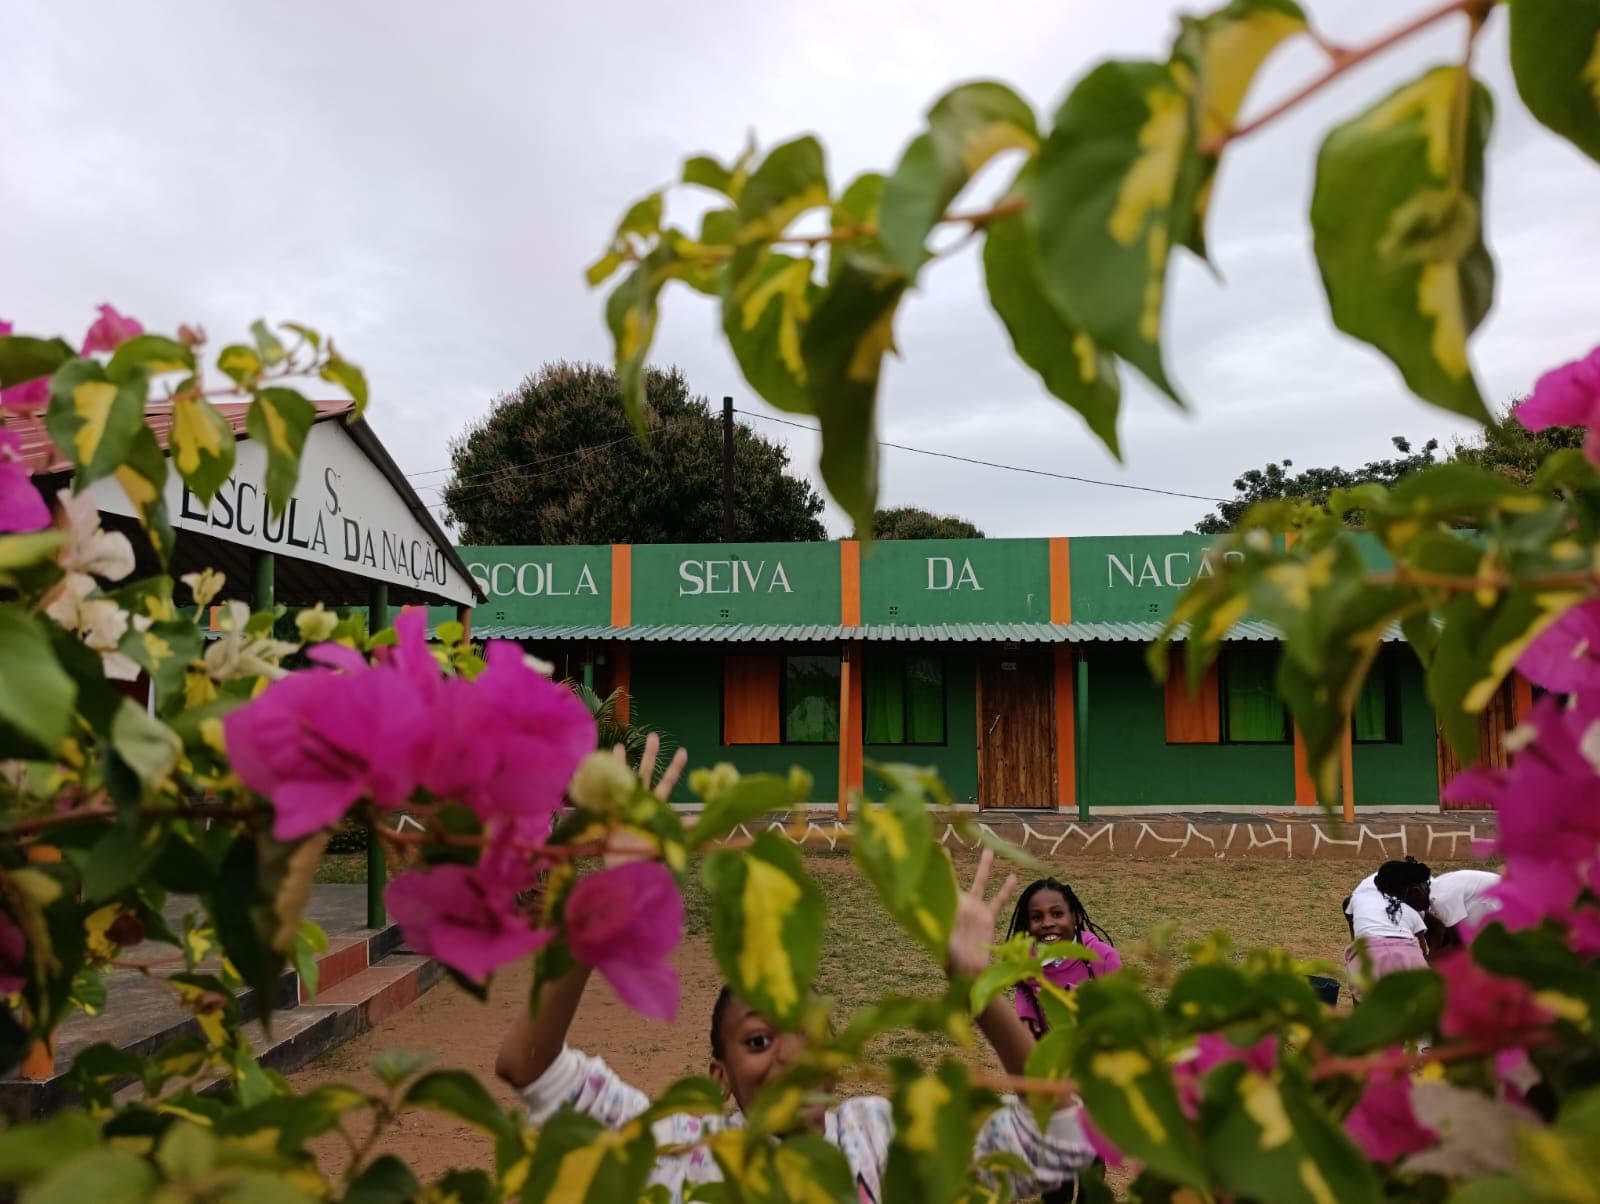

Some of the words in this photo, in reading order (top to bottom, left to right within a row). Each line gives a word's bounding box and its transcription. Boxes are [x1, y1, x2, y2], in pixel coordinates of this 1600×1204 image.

[466, 562, 600, 596] SCOLA
[678, 560, 794, 597] SEIVA
[925, 557, 984, 591] DA
